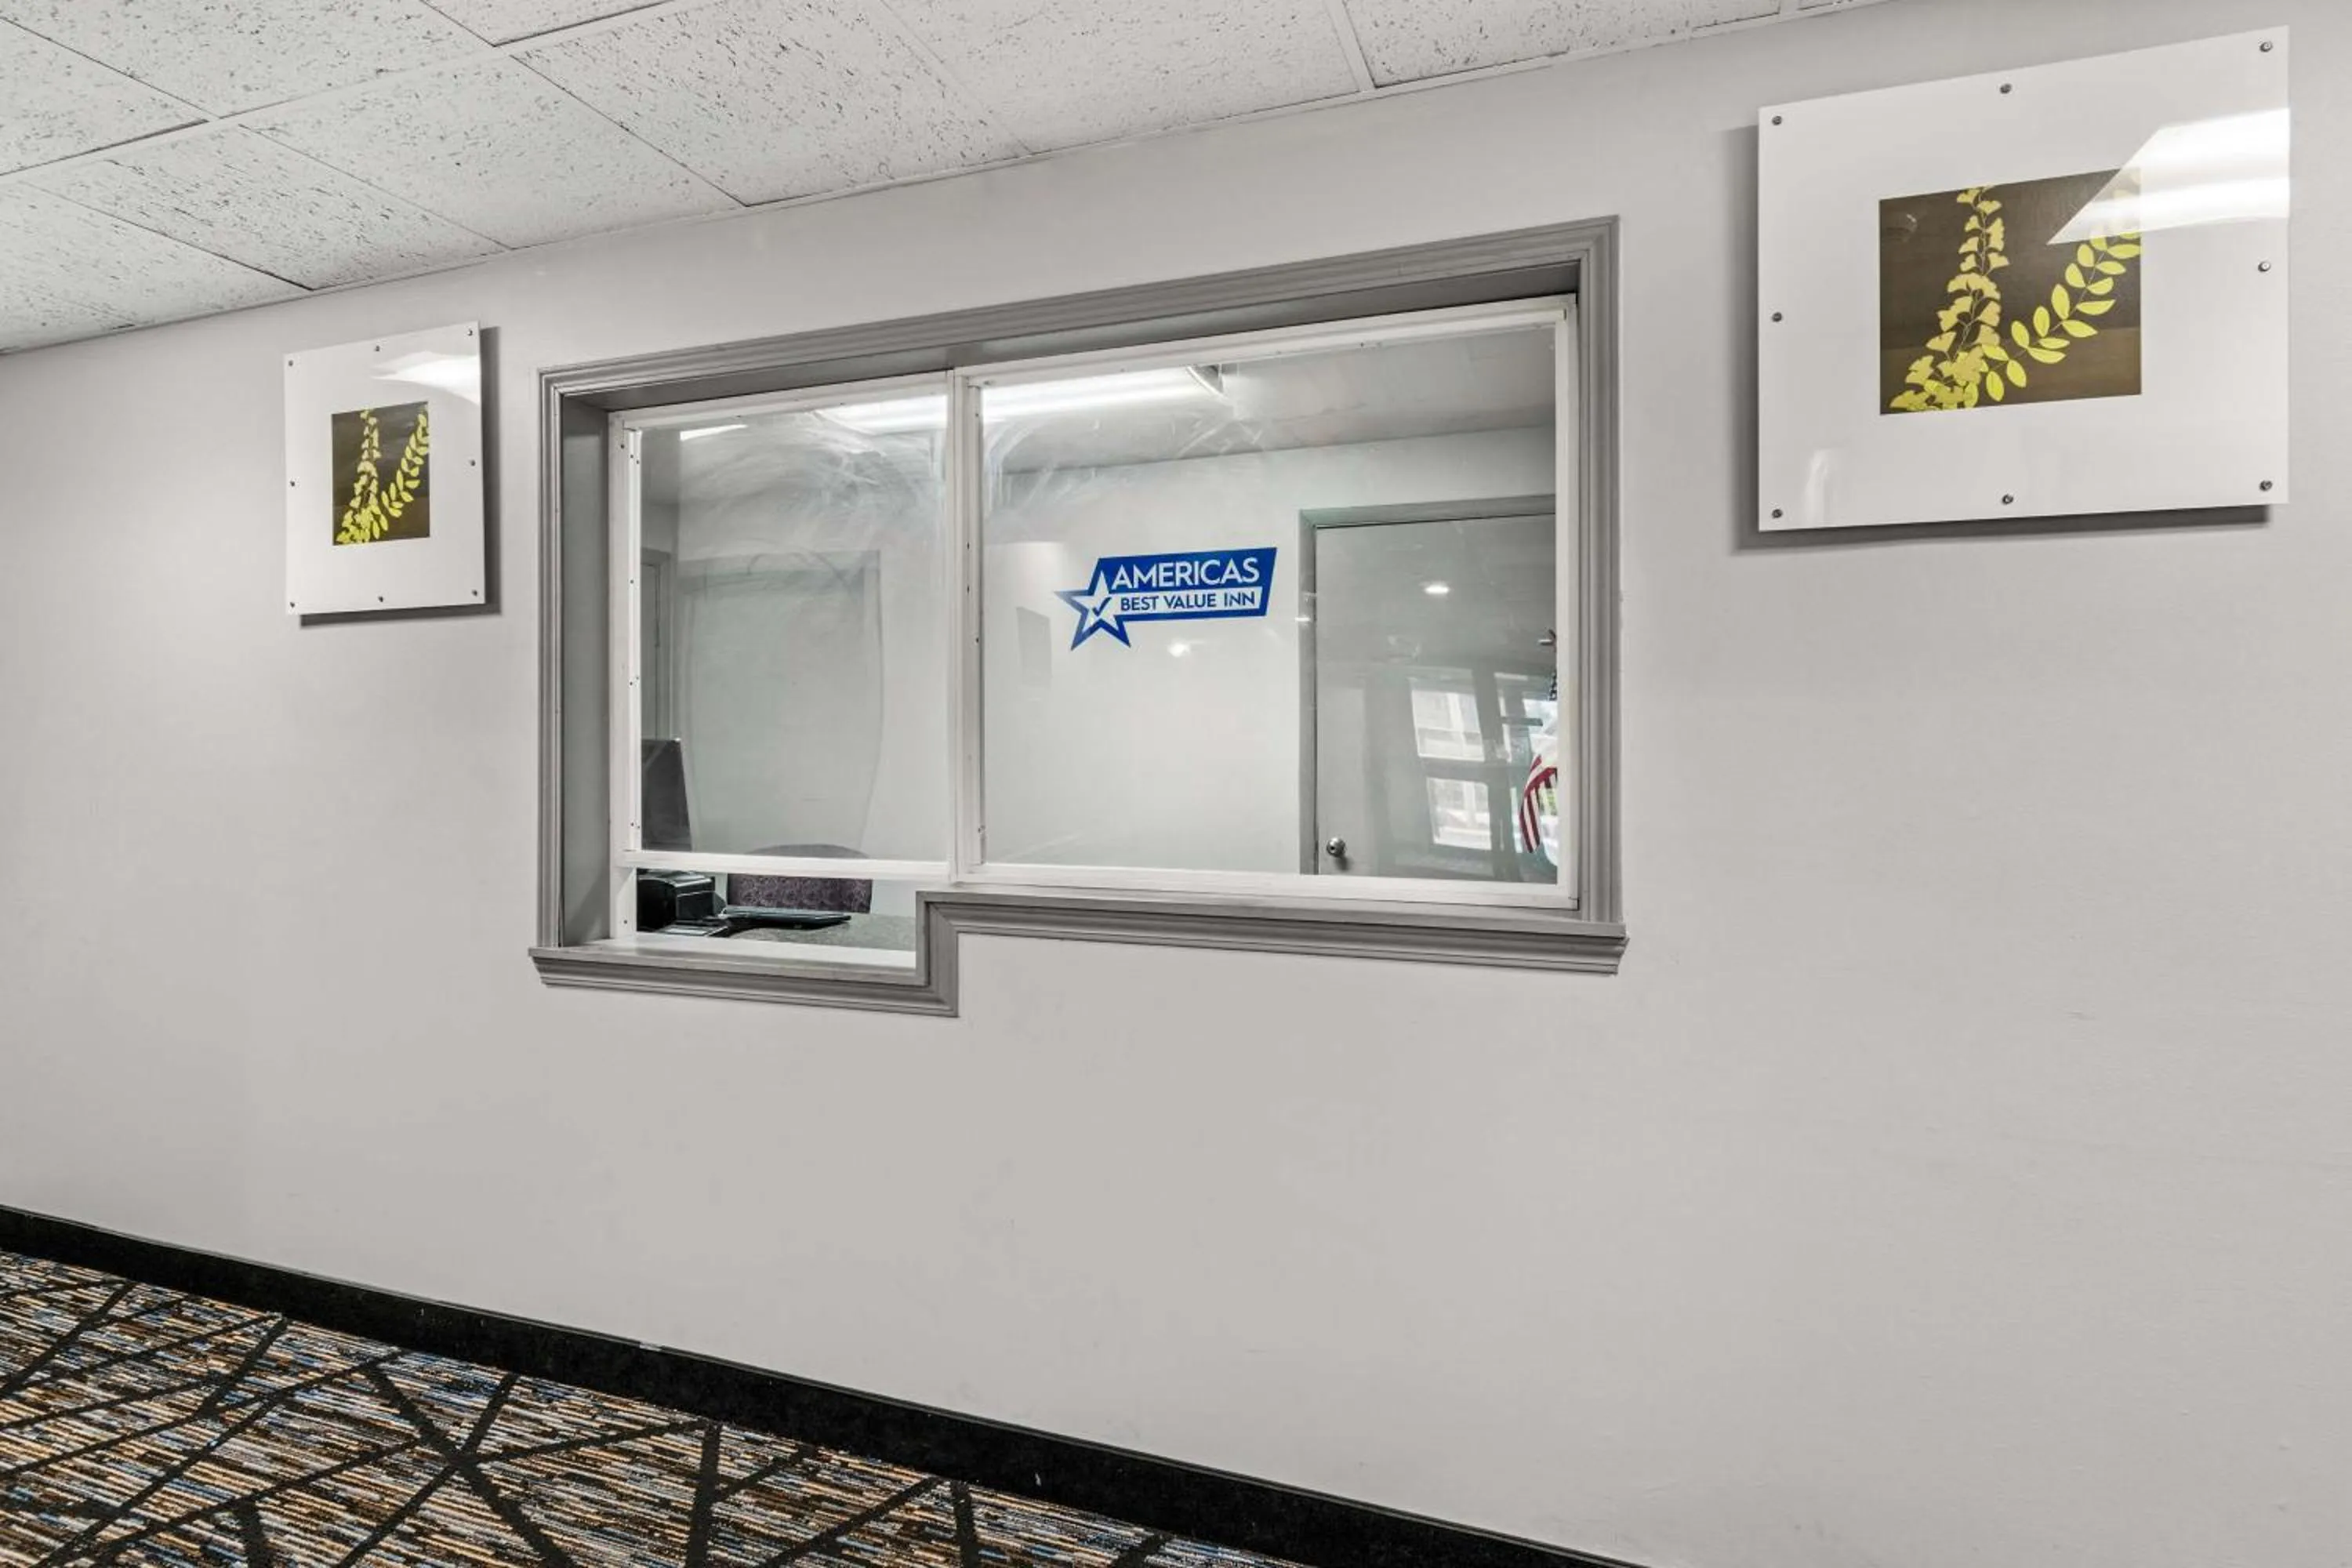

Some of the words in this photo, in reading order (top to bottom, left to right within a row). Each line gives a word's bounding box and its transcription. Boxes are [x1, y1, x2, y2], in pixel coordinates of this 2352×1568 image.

[1112, 557, 1260, 590] AMERICAS
[1120, 595, 1159, 612] BEST
[1163, 593, 1217, 609] VALUE
[1224, 591, 1255, 608] INN
